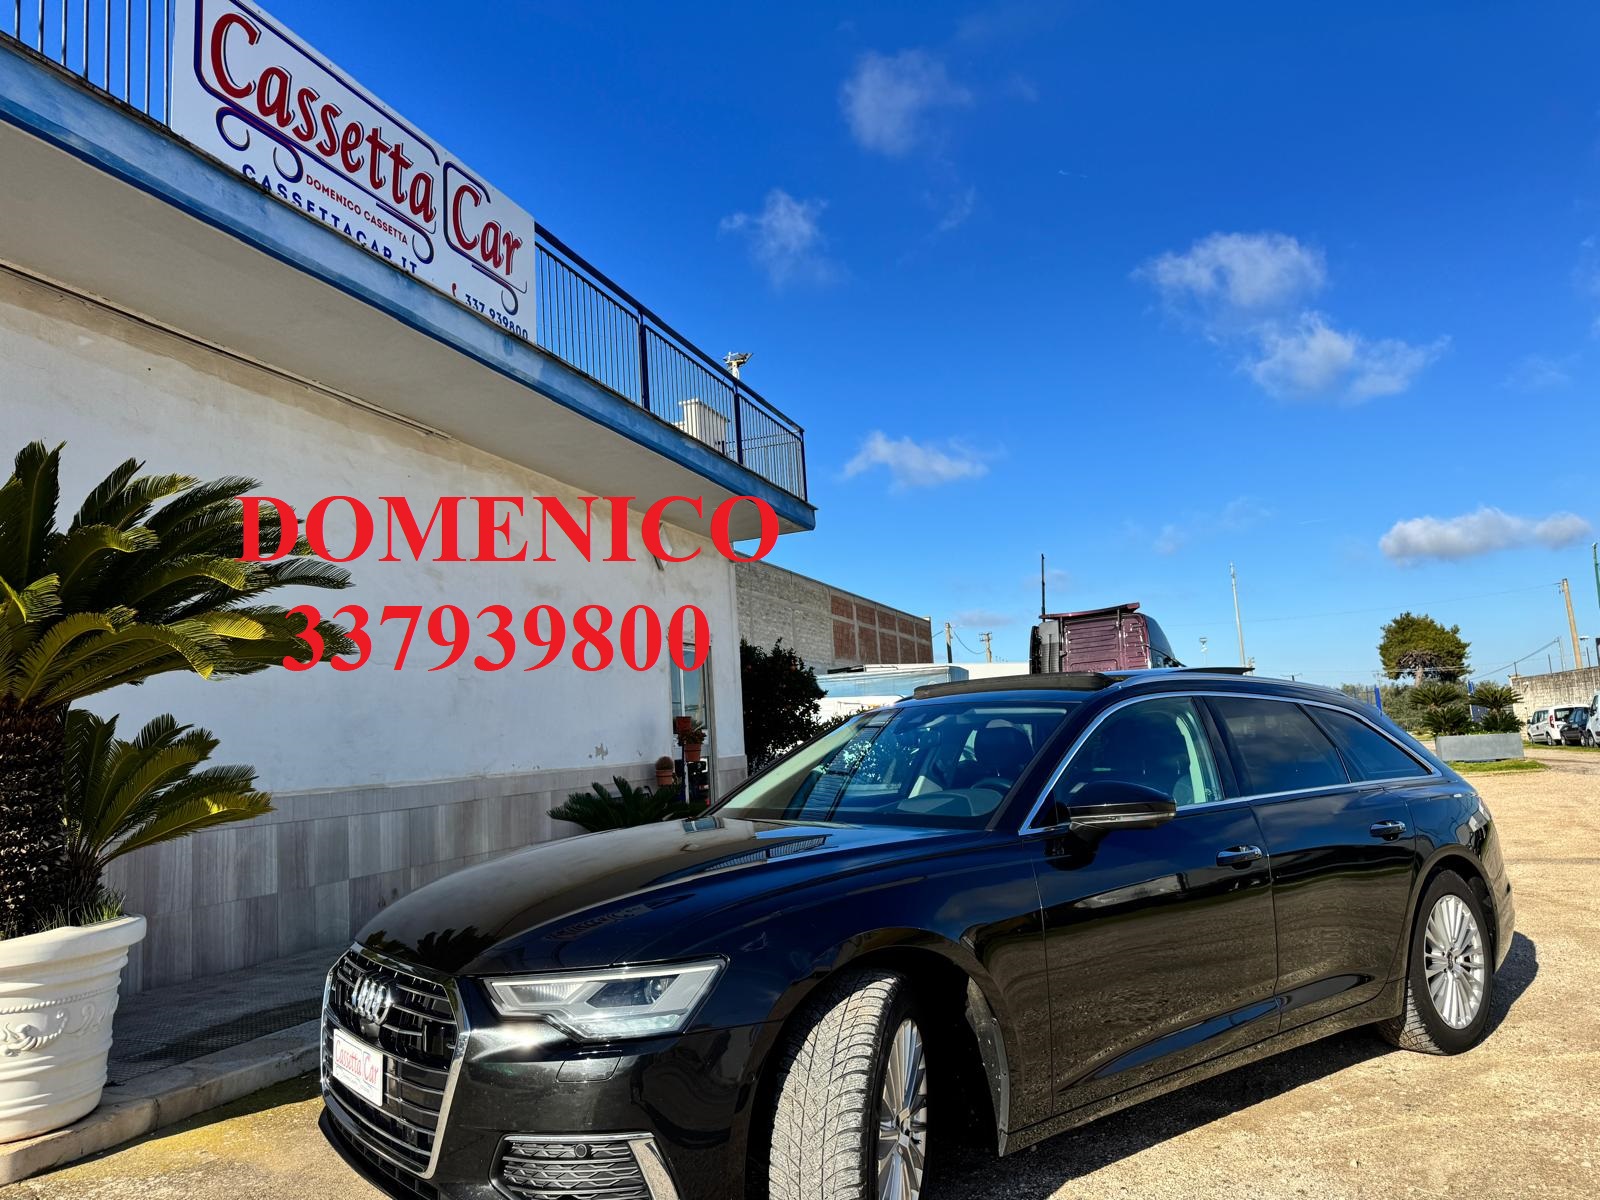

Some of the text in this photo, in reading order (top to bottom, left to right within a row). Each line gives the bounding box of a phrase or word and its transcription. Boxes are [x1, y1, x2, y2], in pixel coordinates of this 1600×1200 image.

[211, 12, 523, 276] Cassetta Car
[306, 174, 408, 246] DOMENICO CASSETTA
[465, 293, 528, 340] 337 939800
